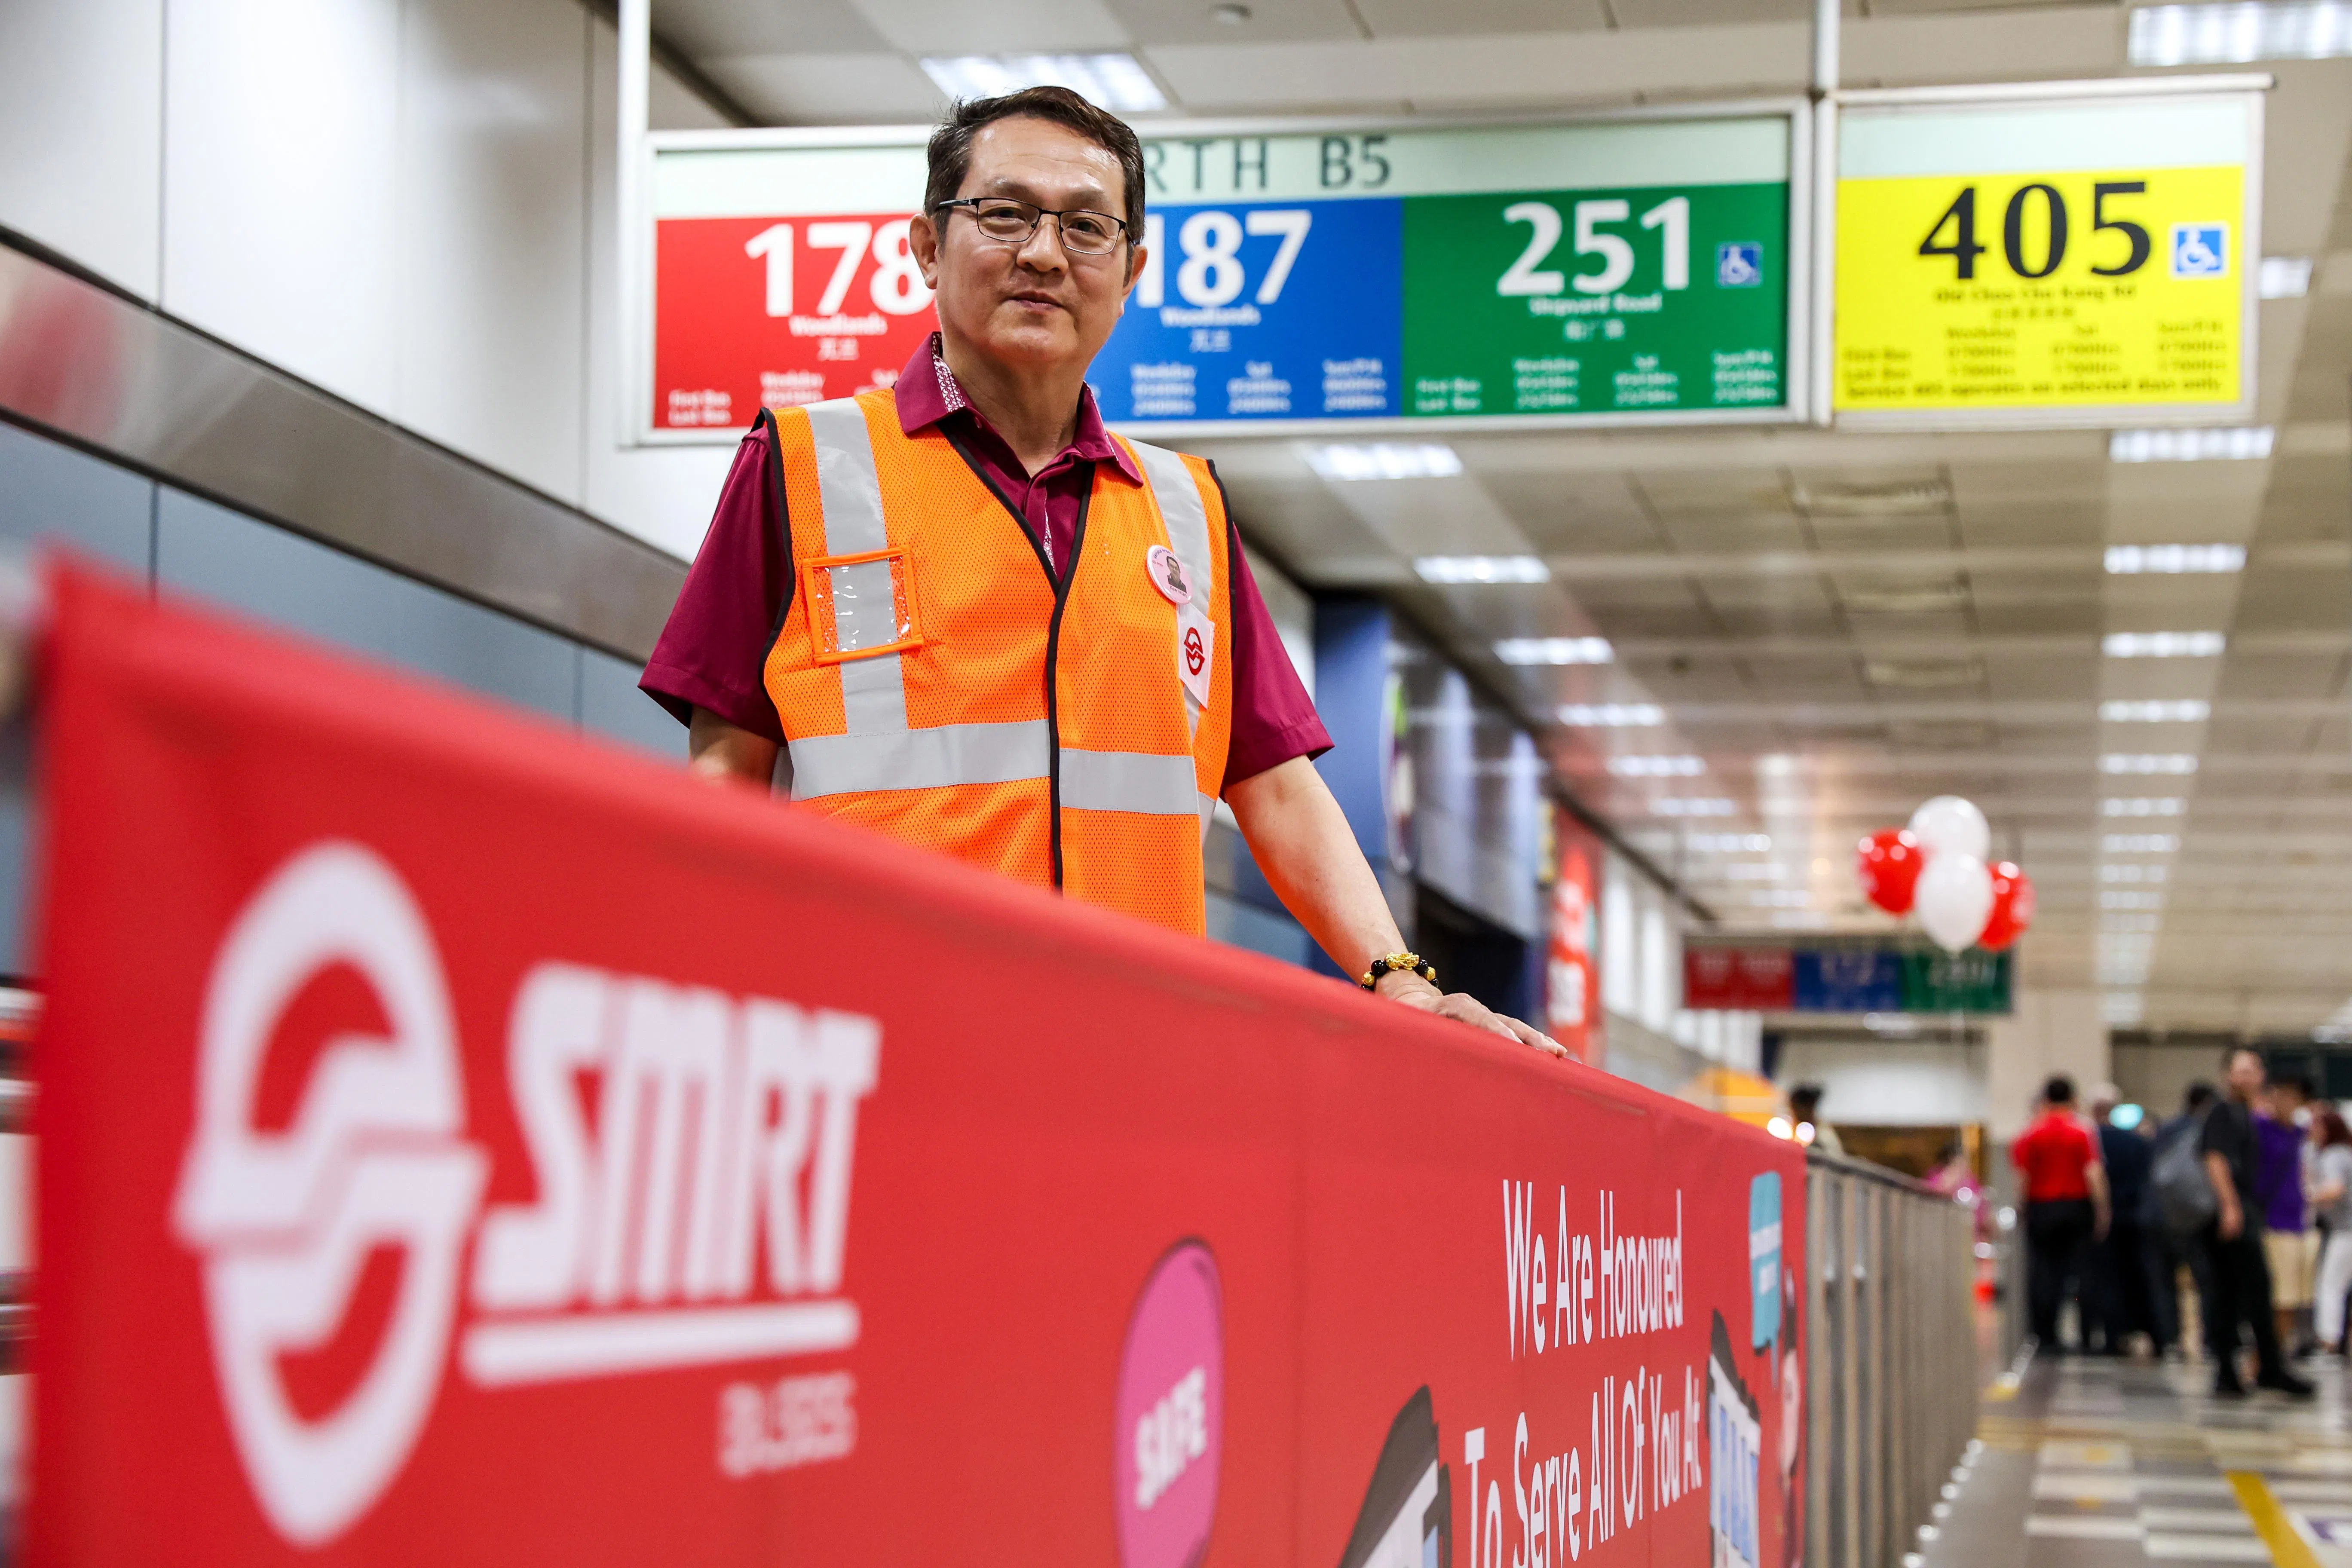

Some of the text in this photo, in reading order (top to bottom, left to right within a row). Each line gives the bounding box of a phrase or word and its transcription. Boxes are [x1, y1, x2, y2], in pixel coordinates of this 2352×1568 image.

[1320, 135, 1391, 190] B5
[744, 220, 935, 317] 178
[1136, 210, 1312, 308] 187
[1497, 196, 1690, 297] 251
[1918, 181, 2152, 280] 405
[470, 960, 882, 1307] SMRT
[1502, 1179, 1547, 1361] We
[1554, 1185, 1593, 1349] Are
[1600, 1188, 1683, 1339] Honoured
[1464, 1365, 1702, 1568] To Serve All Of You At
